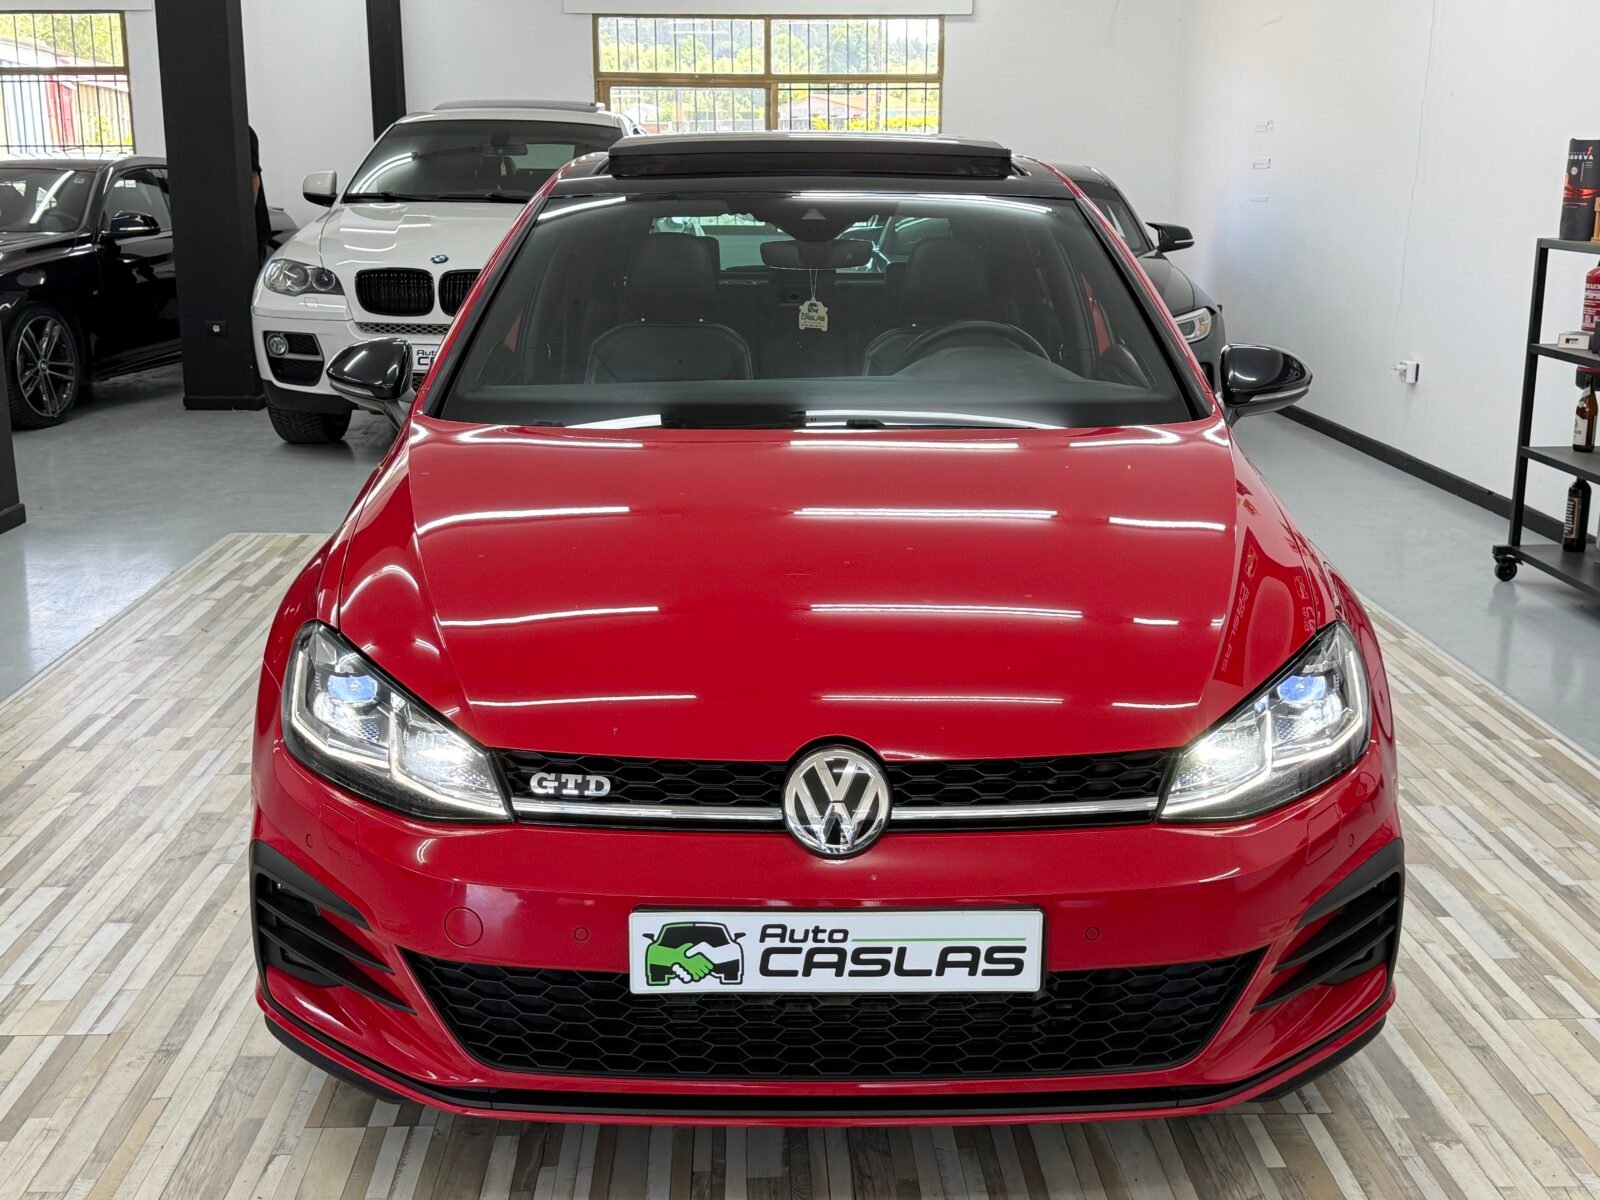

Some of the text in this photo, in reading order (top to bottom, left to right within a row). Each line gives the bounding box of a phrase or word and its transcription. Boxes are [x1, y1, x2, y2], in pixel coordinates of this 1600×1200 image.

[529, 772, 611, 797] GTD
[759, 923, 849, 943] Auto
[759, 945, 1027, 977] CASLAS
